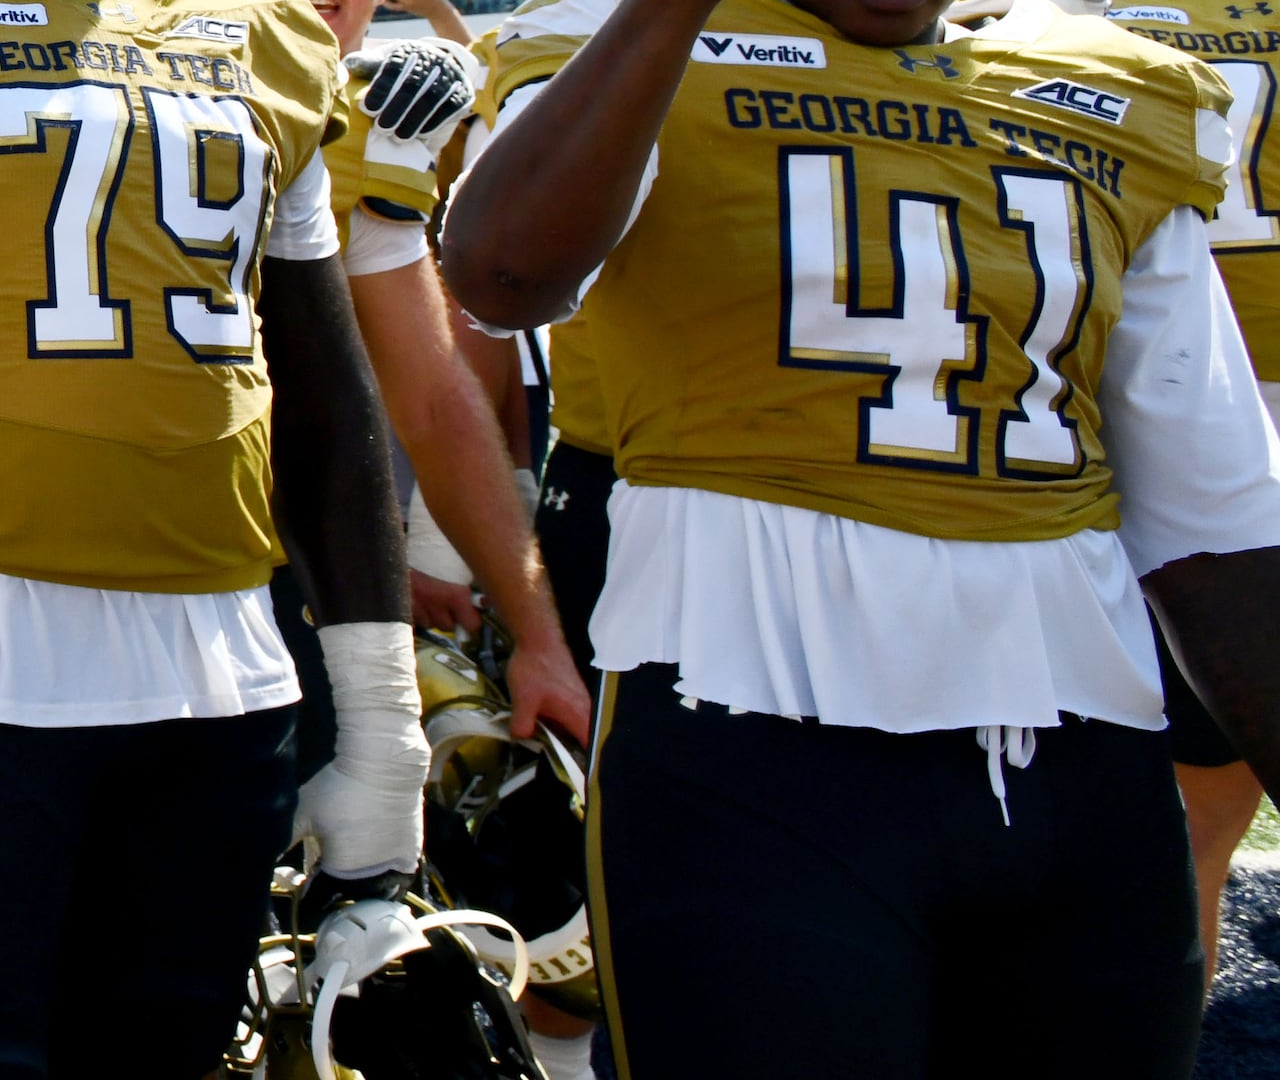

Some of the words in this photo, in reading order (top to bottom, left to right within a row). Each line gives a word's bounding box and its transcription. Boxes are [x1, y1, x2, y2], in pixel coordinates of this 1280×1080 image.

[178, 18, 246, 39] ACC
[157, 51, 257, 94] TECH
[1028, 81, 1128, 119] ACC
[725, 87, 978, 148] GEORGIA
[988, 118, 1125, 200] TECH
[777, 145, 1097, 482] 41
